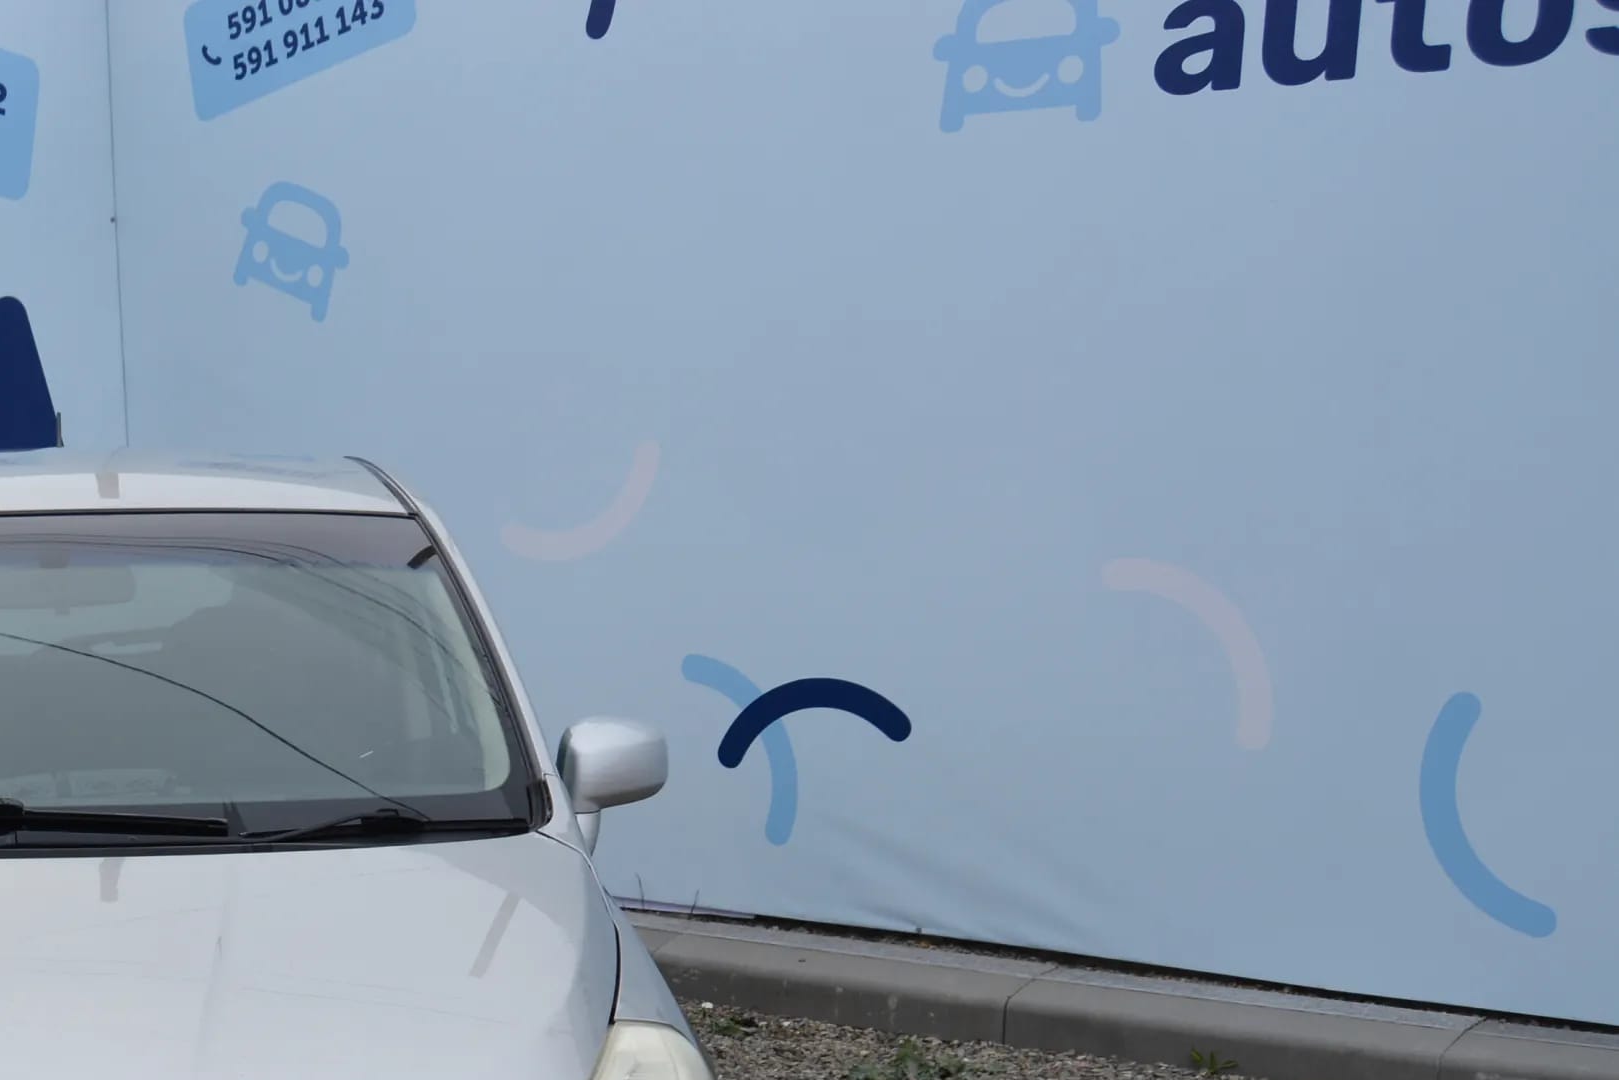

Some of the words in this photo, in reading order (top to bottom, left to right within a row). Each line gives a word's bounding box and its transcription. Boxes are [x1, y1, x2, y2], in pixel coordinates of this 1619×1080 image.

[227, 0, 273, 40] 591
[233, 39, 279, 81] 591
[282, 16, 330, 59] 911
[335, 0, 385, 36] 143
[1153, 0, 1619, 96] auto
